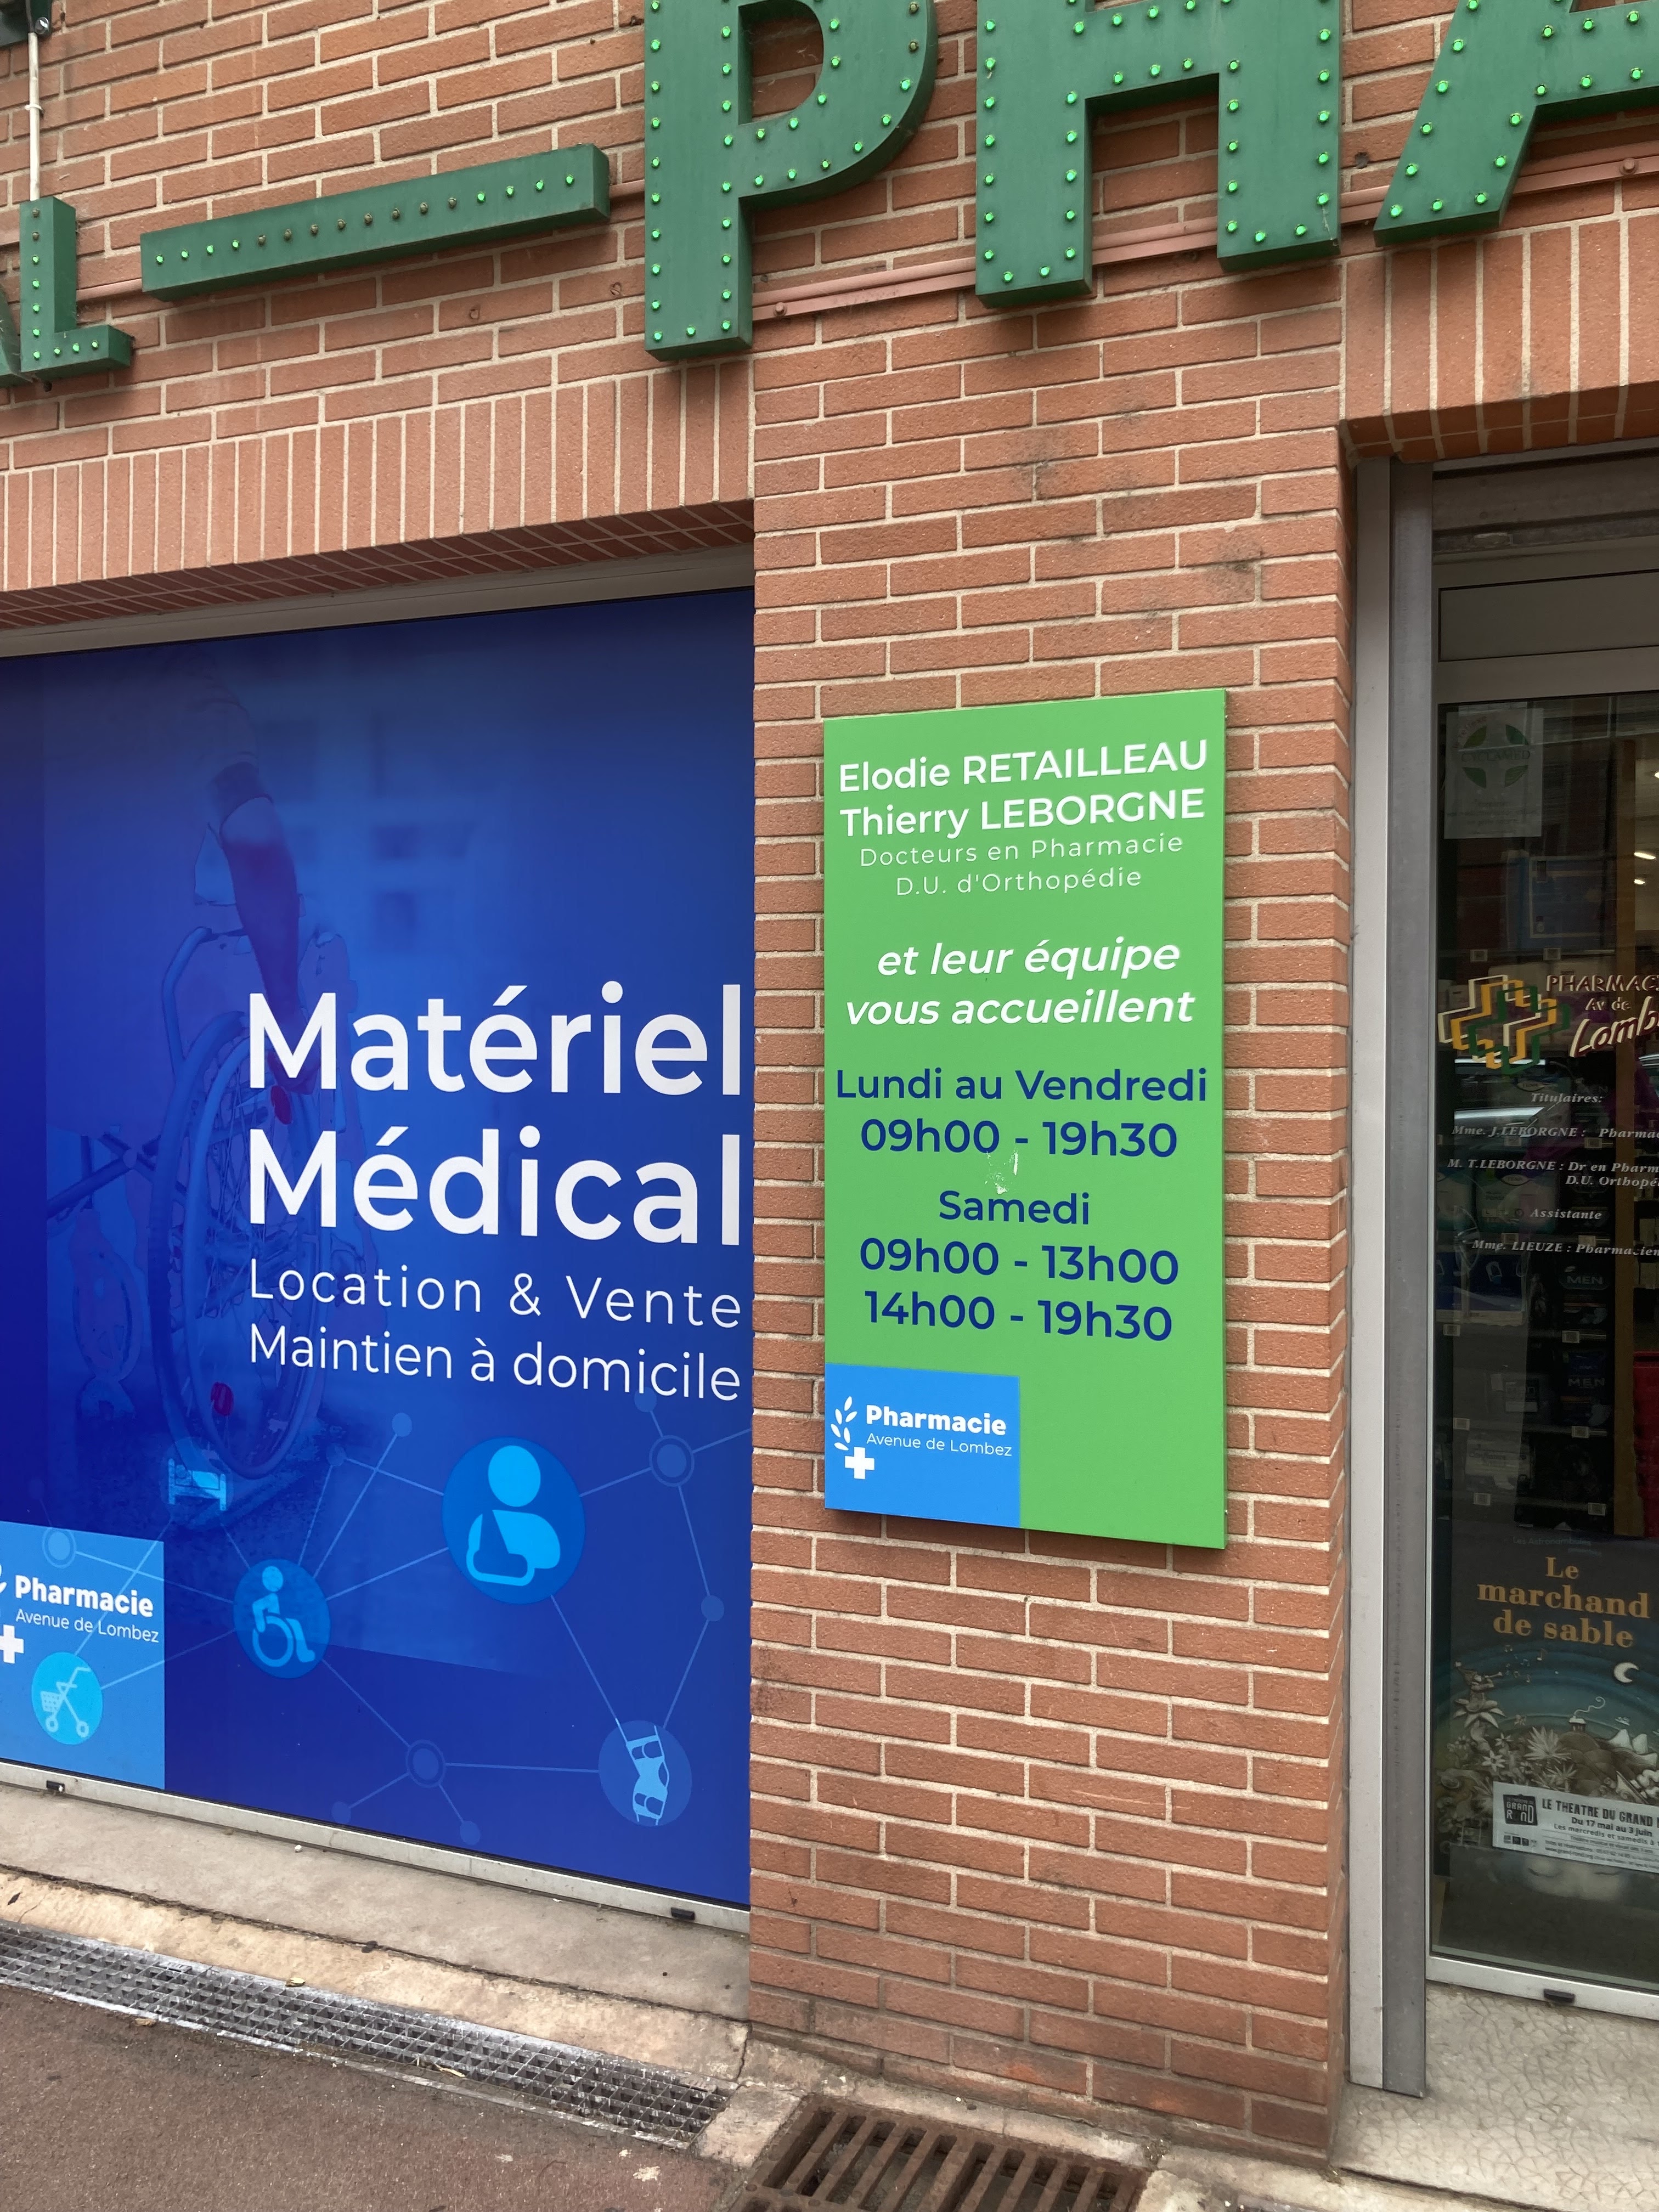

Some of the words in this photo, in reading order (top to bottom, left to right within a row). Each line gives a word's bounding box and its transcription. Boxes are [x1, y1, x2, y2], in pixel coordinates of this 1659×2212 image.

[840, 756, 950, 792] Elodie
[963, 739, 1207, 785] RETAILLEAU
[839, 804, 969, 839] Thierry
[981, 788, 1204, 830] LEBORGNE
[861, 848, 977, 866] Docteurs
[988, 845, 1018, 861] en
[1032, 833, 1183, 859] Pharmacie
[897, 876, 946, 895] D.U.
[957, 867, 1141, 894] d'Orthopédie
[878, 947, 919, 976] et
[930, 943, 1014, 975] leur
[1024, 936, 1180, 980] équipe
[847, 1001, 941, 1025] vous
[951, 989, 1195, 1024] accueillent
[1585, 998, 1606, 1011] Av
[1611, 997, 1632, 1011] de
[250, 980, 741, 1096] Matériel
[1569, 996, 1659, 1058] Lomb
[837, 1067, 942, 1099] Lundi
[956, 1076, 1002, 1099] au
[1014, 1068, 1206, 1101] Vendredi
[1531, 1093, 1602, 1103] Titulaires:
[861, 1118, 1000, 1154] 09h00
[1042, 1120, 1177, 1158] 19h30
[1452, 1126, 1485, 1135] Mme.
[1447, 1159, 1462, 1168] M.
[1468, 1159, 1556, 1170] T.LEBORGNE
[1567, 1161, 1587, 1171] Dr
[1611, 1163, 1659, 1173] Pharm
[1565, 1176, 1593, 1186] D.U.
[1599, 1176, 1659, 1189] Orthopé
[250, 1125, 740, 1246] Médical
[939, 1190, 1089, 1225] Samedi
[1530, 1209, 1602, 1219] Assistante
[860, 1237, 999, 1276] 09h00
[1041, 1245, 1178, 1285] 13h00
[1472, 1240, 1506, 1250] Mme.
[1511, 1242, 1562, 1252] LIEUZE
[251, 1258, 481, 1312] Location
[510, 1273, 541, 1316] &
[566, 1276, 741, 1328] Vente
[865, 1290, 995, 1330] 14h00
[1037, 1300, 1172, 1341] 19h30
[251, 1323, 452, 1379] Maintien
[471, 1338, 494, 1382] à
[514, 1341, 740, 1401] domicile
[866, 1404, 1006, 1436] Pharmacie
[866, 1432, 921, 1448] Avenue
[926, 1437, 945, 1451] de
[950, 1440, 1012, 1457] Lombez
[1545, 1556, 1579, 1579] Le
[15, 1575, 153, 1617] Pharmacie
[1477, 1583, 1650, 1618] marchand
[15, 1609, 70, 1629] Avenue
[74, 1617, 93, 1633] de
[98, 1620, 159, 1643] Lombez
[1493, 1609, 1532, 1636] de
[1544, 1617, 1633, 1648] sable
[1542, 1798, 1551, 1810] LE
[1556, 1800, 1599, 1818] THEATRE
[1602, 1808, 1615, 1821] DU
[1620, 1811, 1652, 1826] GRAND
